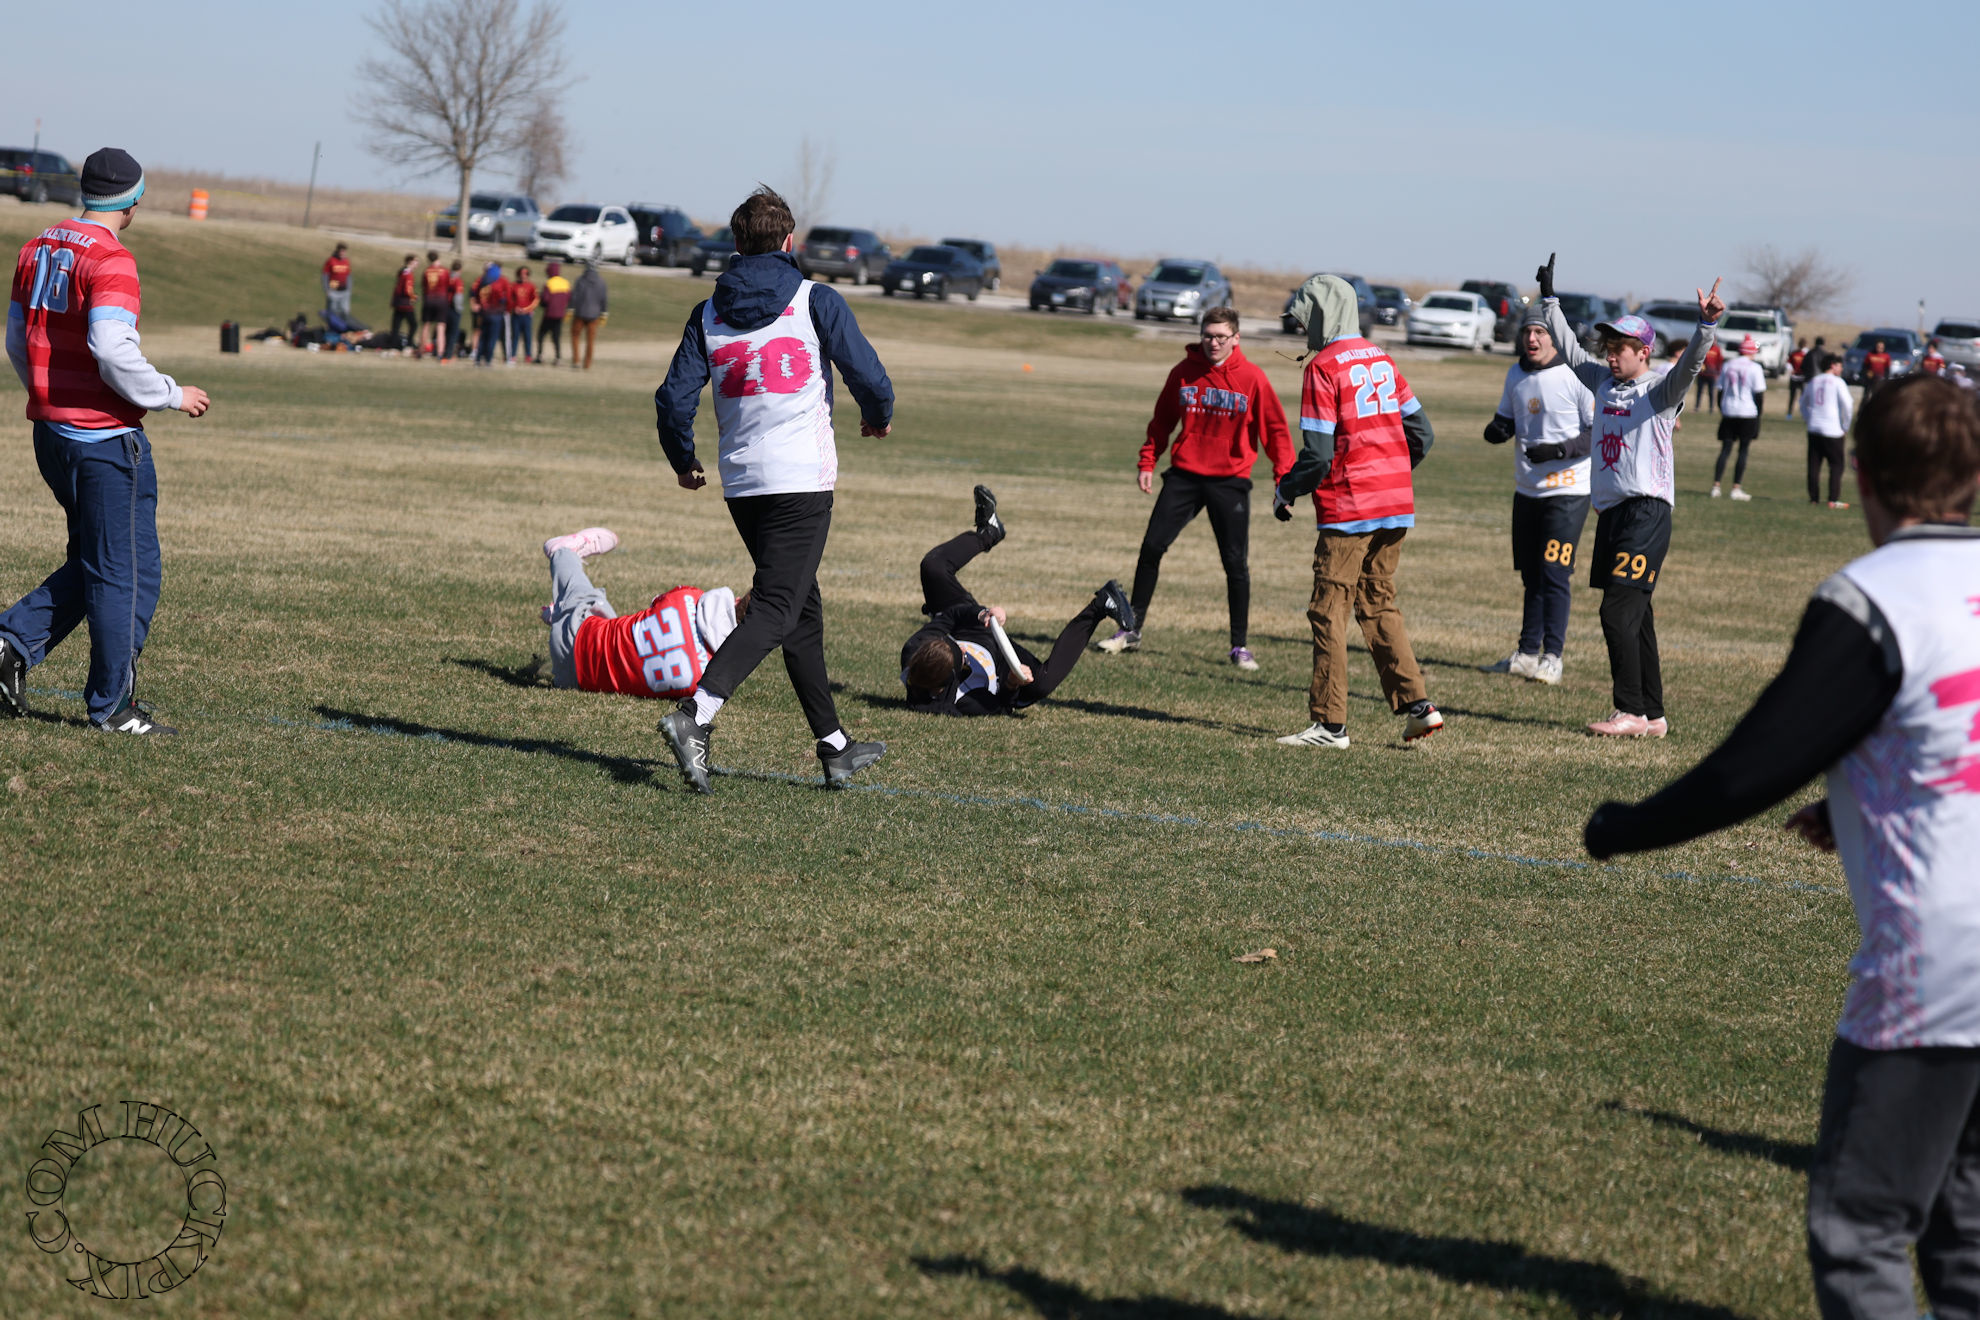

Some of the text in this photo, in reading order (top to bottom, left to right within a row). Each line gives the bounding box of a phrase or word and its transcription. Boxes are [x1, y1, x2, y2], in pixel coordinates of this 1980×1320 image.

[30, 244, 75, 314] 16
[708, 336, 814, 399] 20
[1201, 387, 1249, 413] JOHN'S
[1349, 361, 1400, 419] 22
[1546, 469, 1577, 488] 88
[1545, 538, 1573, 567] 88
[1611, 551, 1647, 581] 29
[631, 606, 694, 693] 28
